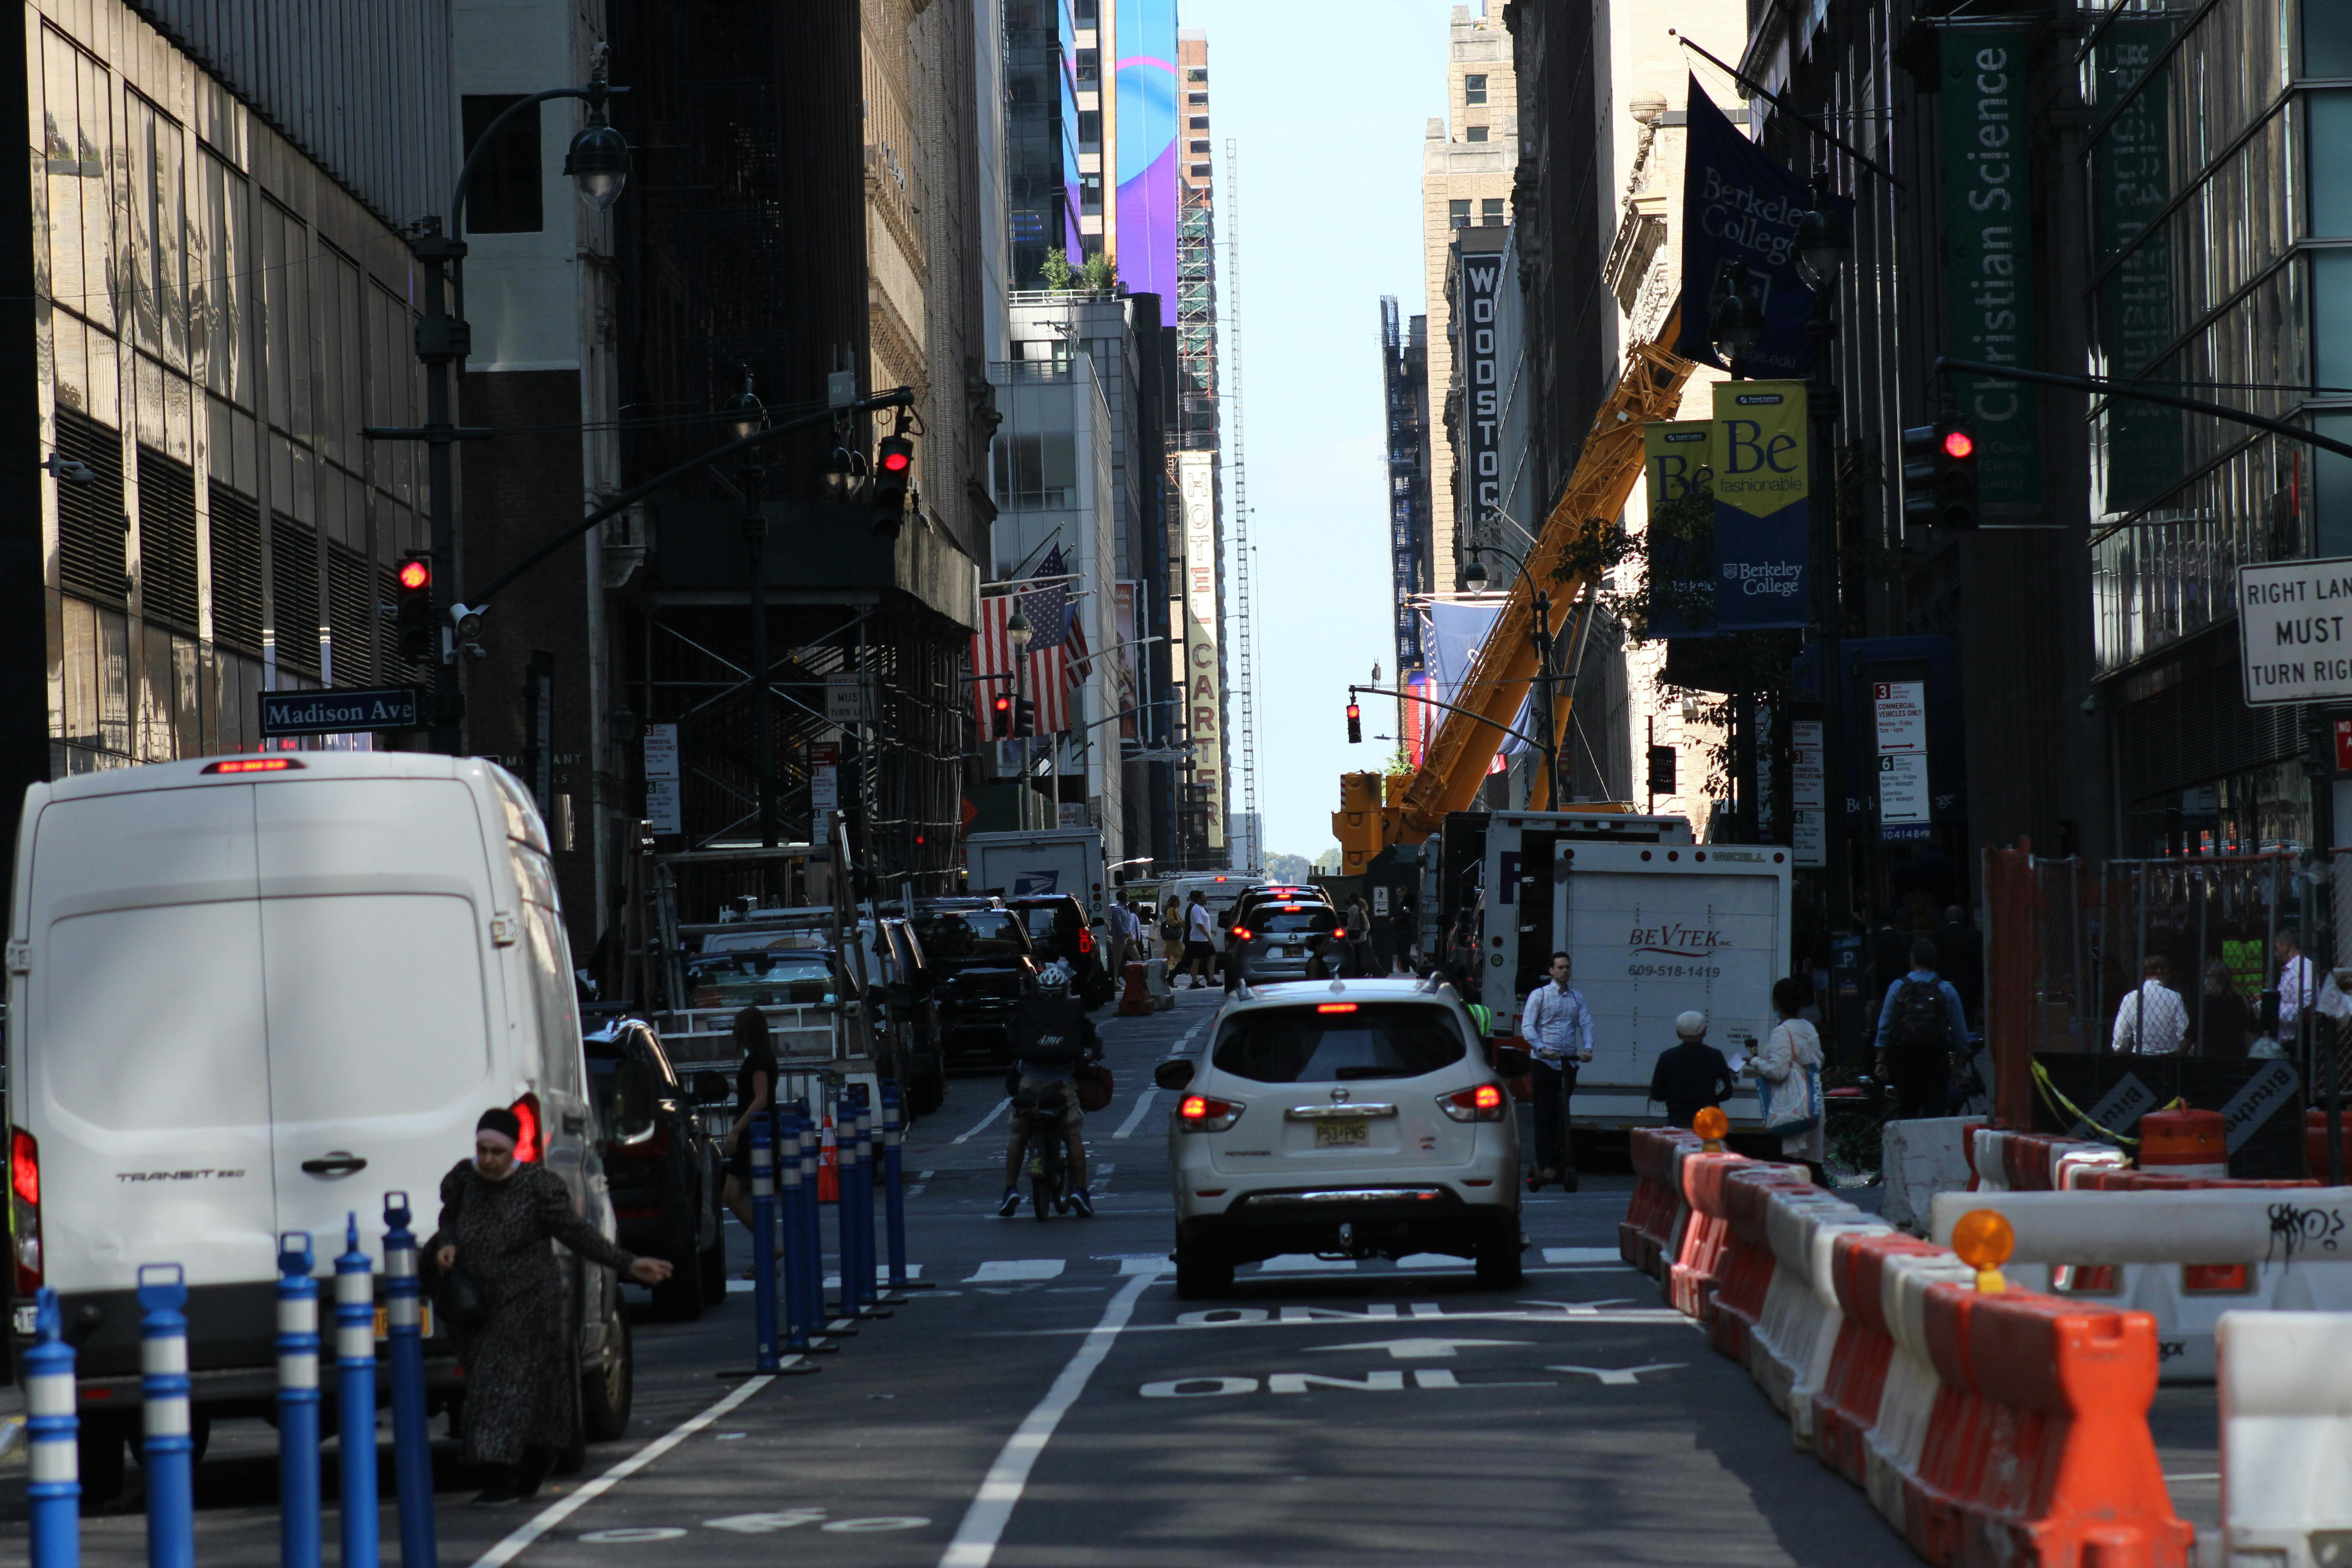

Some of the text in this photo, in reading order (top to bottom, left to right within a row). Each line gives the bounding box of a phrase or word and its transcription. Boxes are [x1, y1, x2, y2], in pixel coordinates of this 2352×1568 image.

[1967, 48, 2011, 211] Science
[1701, 165, 1807, 228] Berkele
[1970, 226, 2018, 422] Christian
[1721, 420, 1798, 474] Be
[1652, 455, 1714, 503] Be
[1720, 477, 1803, 492] fashionable
[1980, 477, 2026, 489] cientist
[1188, 472, 1211, 623] HOTEL
[1739, 561, 1803, 581] Berkeley
[1743, 577, 1799, 597] College
[2247, 578, 2352, 605] RIGHT LAN
[2276, 616, 2344, 646] MUST
[2252, 659, 2352, 686] TURN RIG
[1879, 685, 1887, 699] 3
[268, 700, 413, 725] Madison Ave
[646, 724, 651, 735] 3
[1193, 643, 1218, 826] CARTER
[2338, 721, 2351, 733] NO
[1882, 757, 1890, 770] 6
[648, 782, 654, 792] 6
[815, 810, 819, 818] 6
[1796, 811, 1801, 823] 6
[1628, 965, 1720, 978] 609-518-1419
[2226, 1067, 2291, 1134] Bituthe
[117, 1169, 215, 1182] TRANSIT
[1176, 1298, 1637, 1327] ONLY
[1140, 1363, 1690, 1399] ONLY
